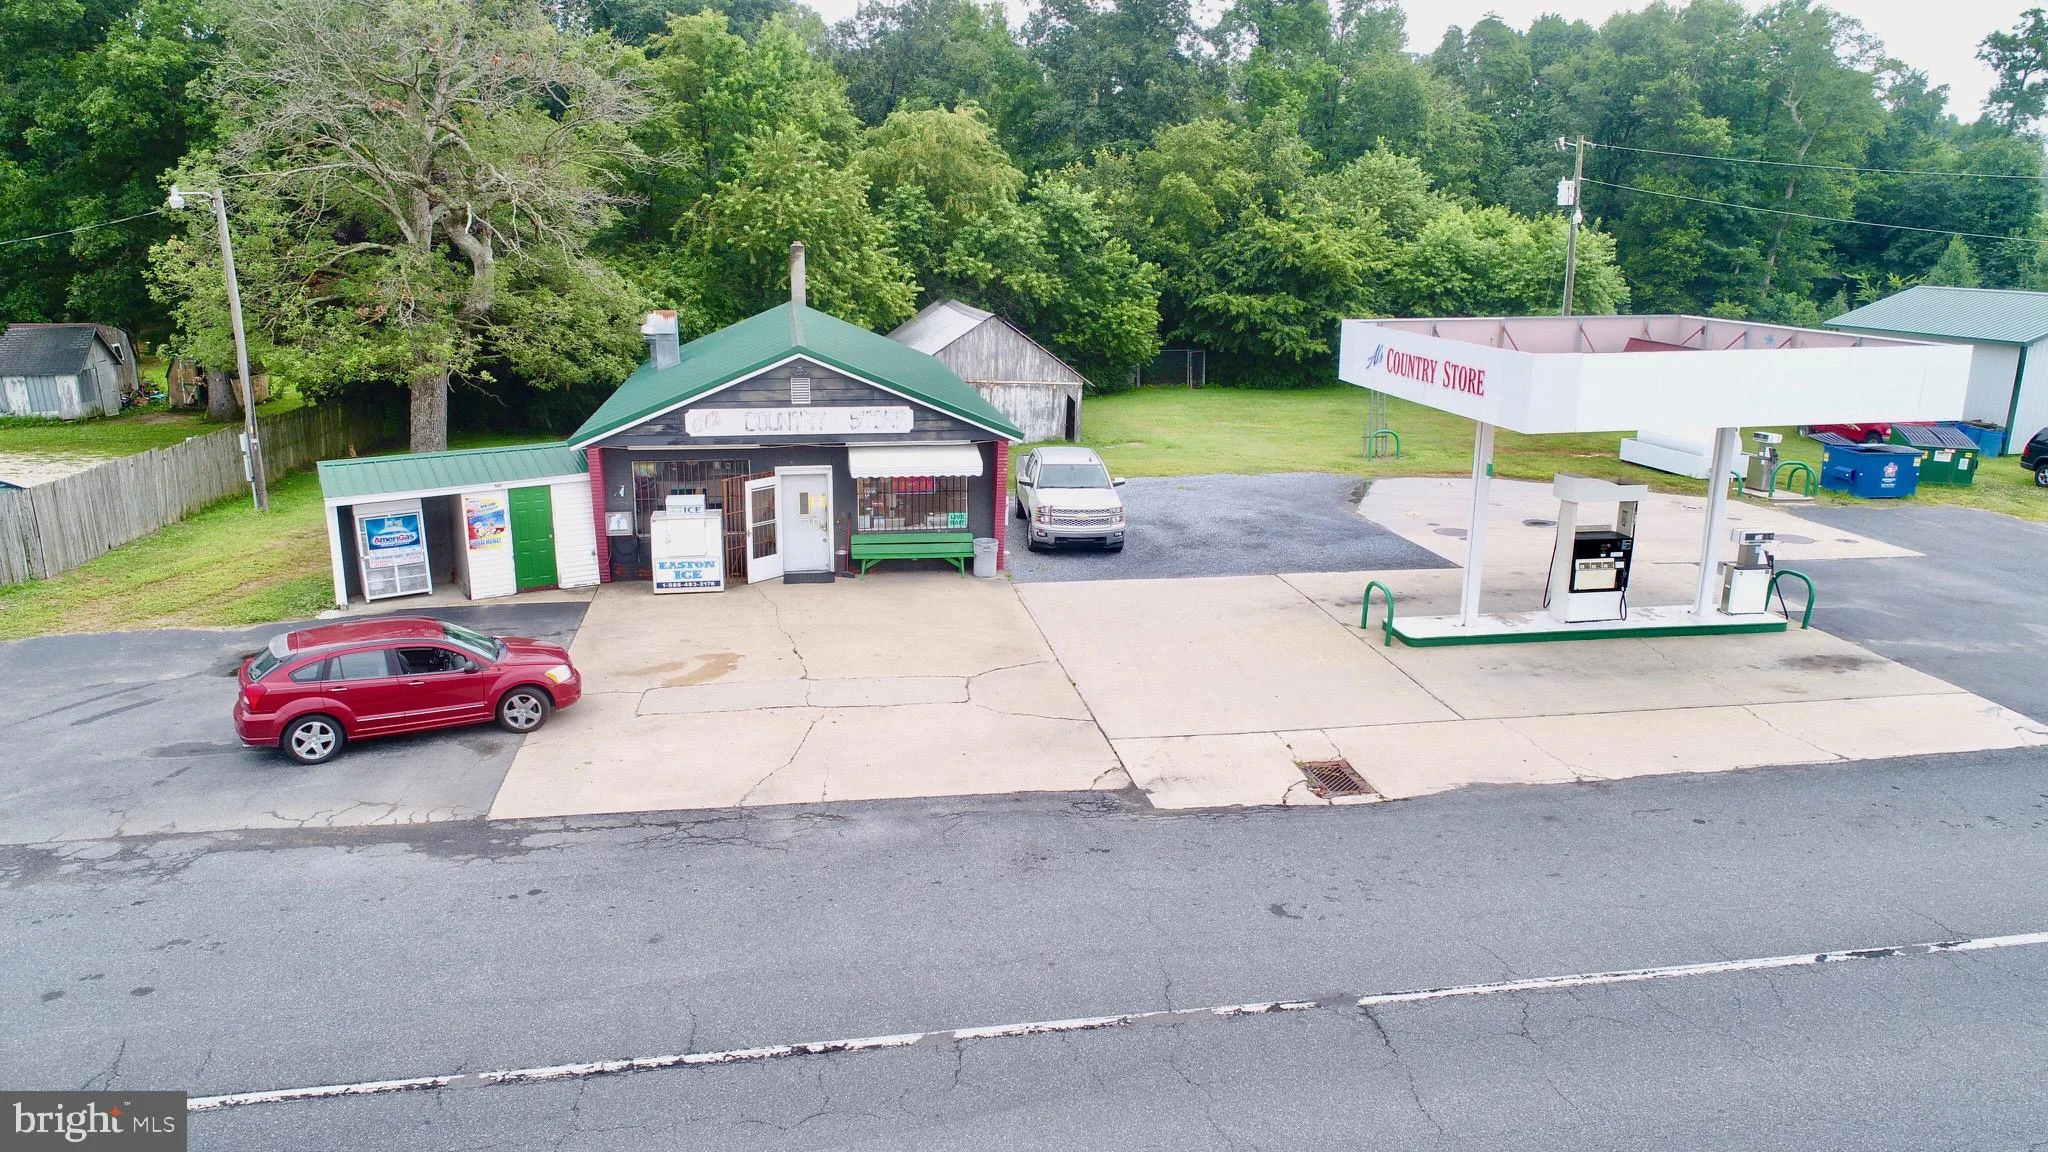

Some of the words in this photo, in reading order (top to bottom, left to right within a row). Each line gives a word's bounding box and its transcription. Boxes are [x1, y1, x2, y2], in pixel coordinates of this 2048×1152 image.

[1386, 348, 1438, 384] COUNTRY
[1442, 361, 1486, 396] STORE
[374, 533, 415, 544] AmeriGas
[658, 561, 716, 570] EASTON
[674, 570, 703, 579] ICE
